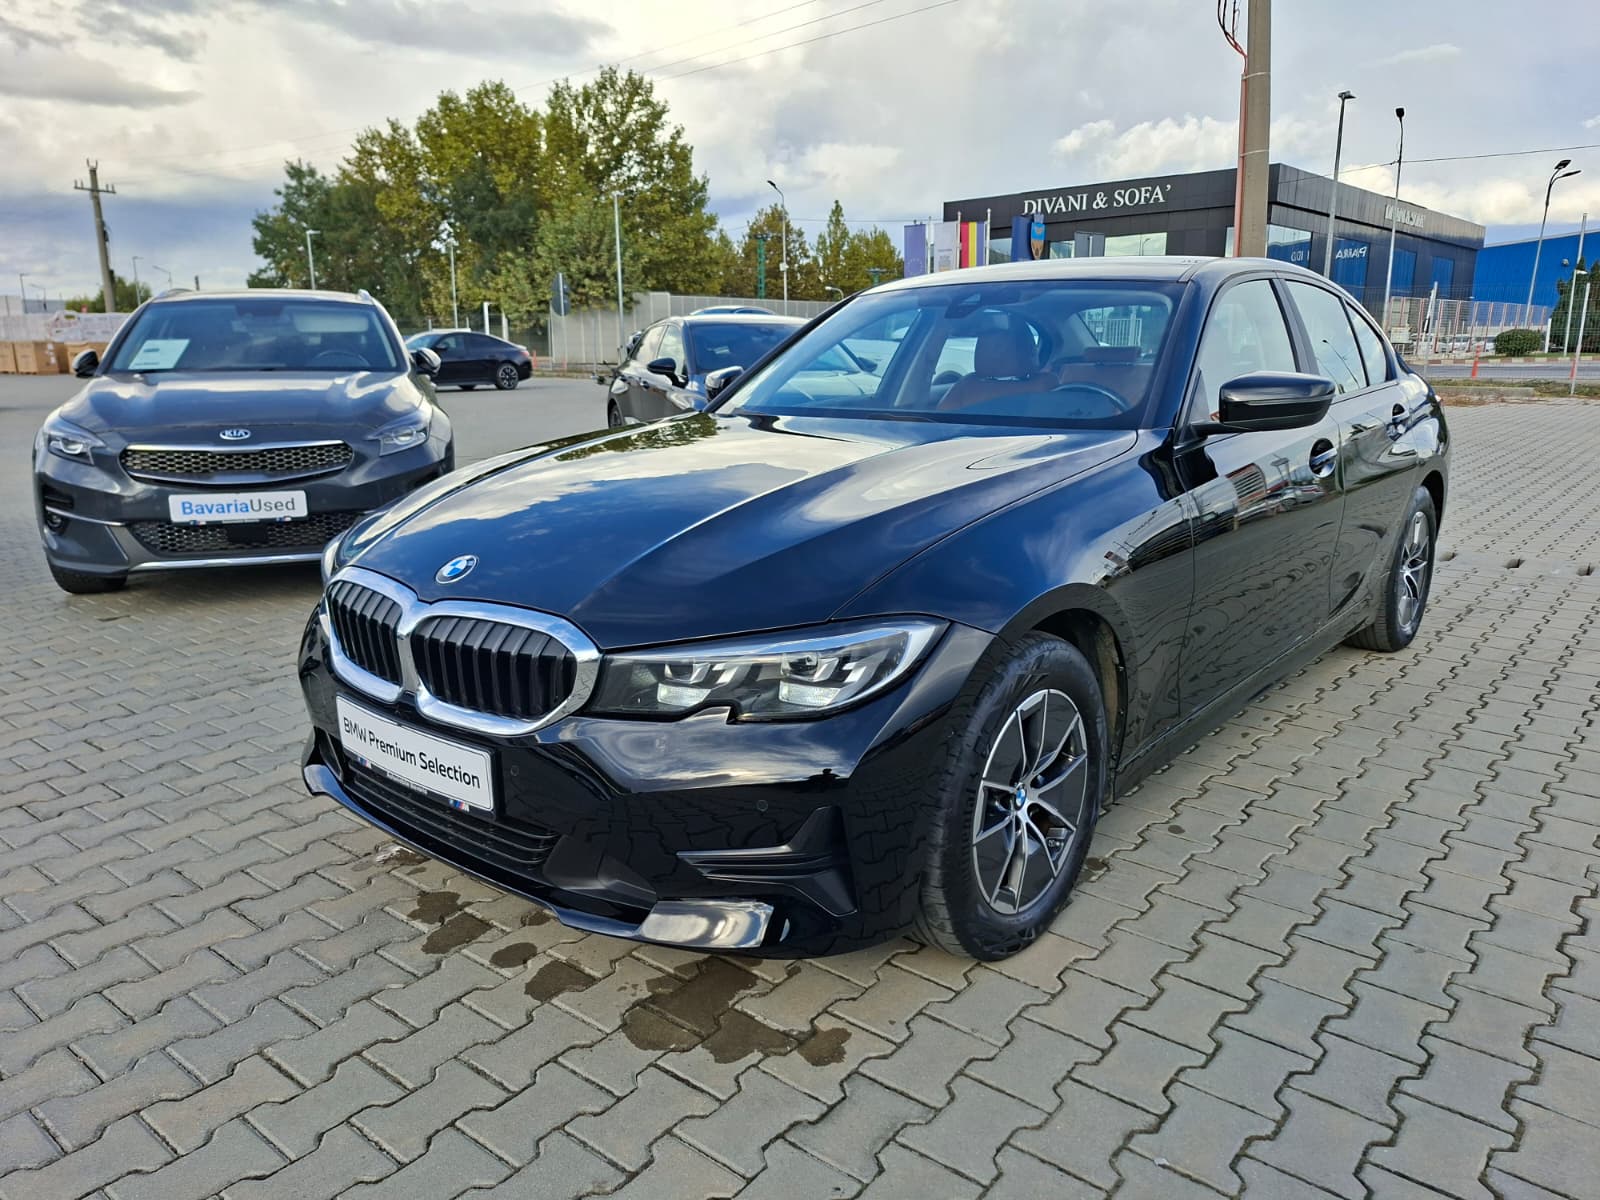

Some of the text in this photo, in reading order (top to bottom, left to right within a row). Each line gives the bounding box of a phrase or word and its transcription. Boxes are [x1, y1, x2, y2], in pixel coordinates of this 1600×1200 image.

[1022, 193, 1088, 215] DIVANI
[1092, 191, 1108, 210] &
[224, 429, 246, 437] KIA
[181, 497, 296, 515] BavariaUsed
[343, 717, 367, 743] BMW
[369, 731, 417, 766] Premium
[419, 752, 481, 789] Selection
